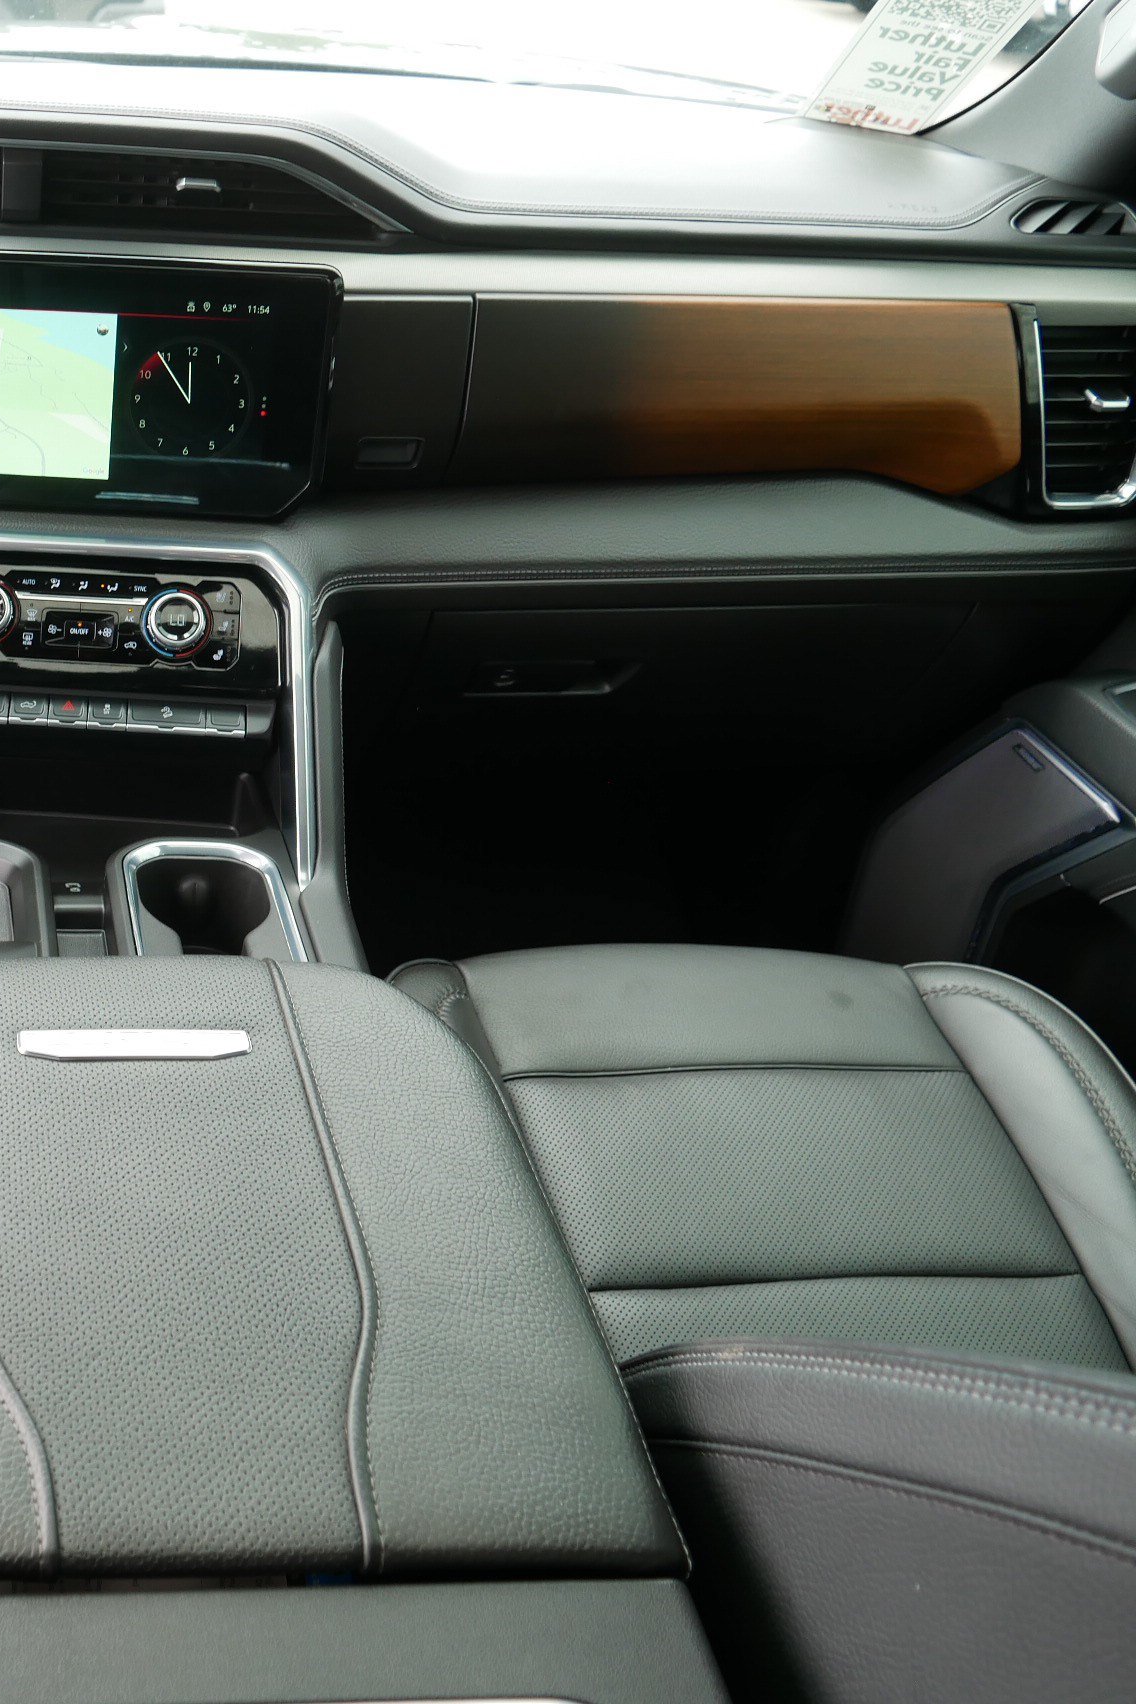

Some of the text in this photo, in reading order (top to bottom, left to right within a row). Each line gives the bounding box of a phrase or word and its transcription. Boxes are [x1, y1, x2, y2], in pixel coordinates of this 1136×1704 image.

[248, 305, 270, 315] 11:54
[187, 347, 198, 356] 12
[139, 370, 151, 380] 10
[233, 375, 240, 384] 2
[135, 394, 141, 404] 9
[239, 399, 245, 409] 3
[139, 419, 146, 429] 8
[228, 424, 235, 433] 4
[157, 438, 163, 447] 7
[209, 441, 215, 450] 5
[182, 447, 188, 456] 6
[82, 466, 104, 475] Google
[22, 578, 36, 586] AUTO
